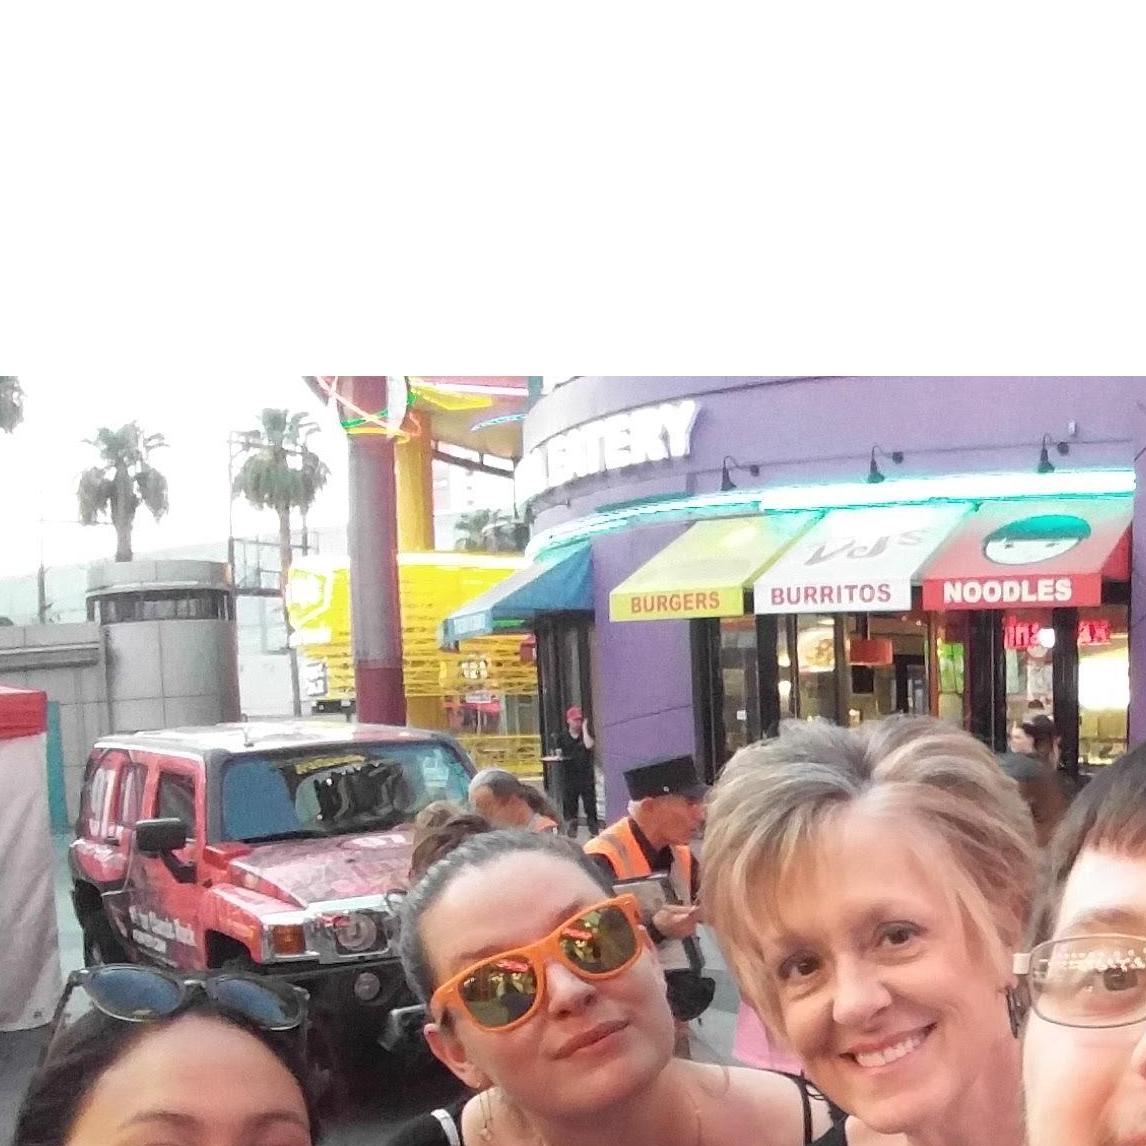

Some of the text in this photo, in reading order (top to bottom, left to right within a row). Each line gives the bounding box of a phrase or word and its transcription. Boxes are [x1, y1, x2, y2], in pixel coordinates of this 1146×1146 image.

[771, 583, 892, 605] BURRITOS
[943, 578, 1072, 603] NOODLES
[631, 592, 720, 613] BURGERS
